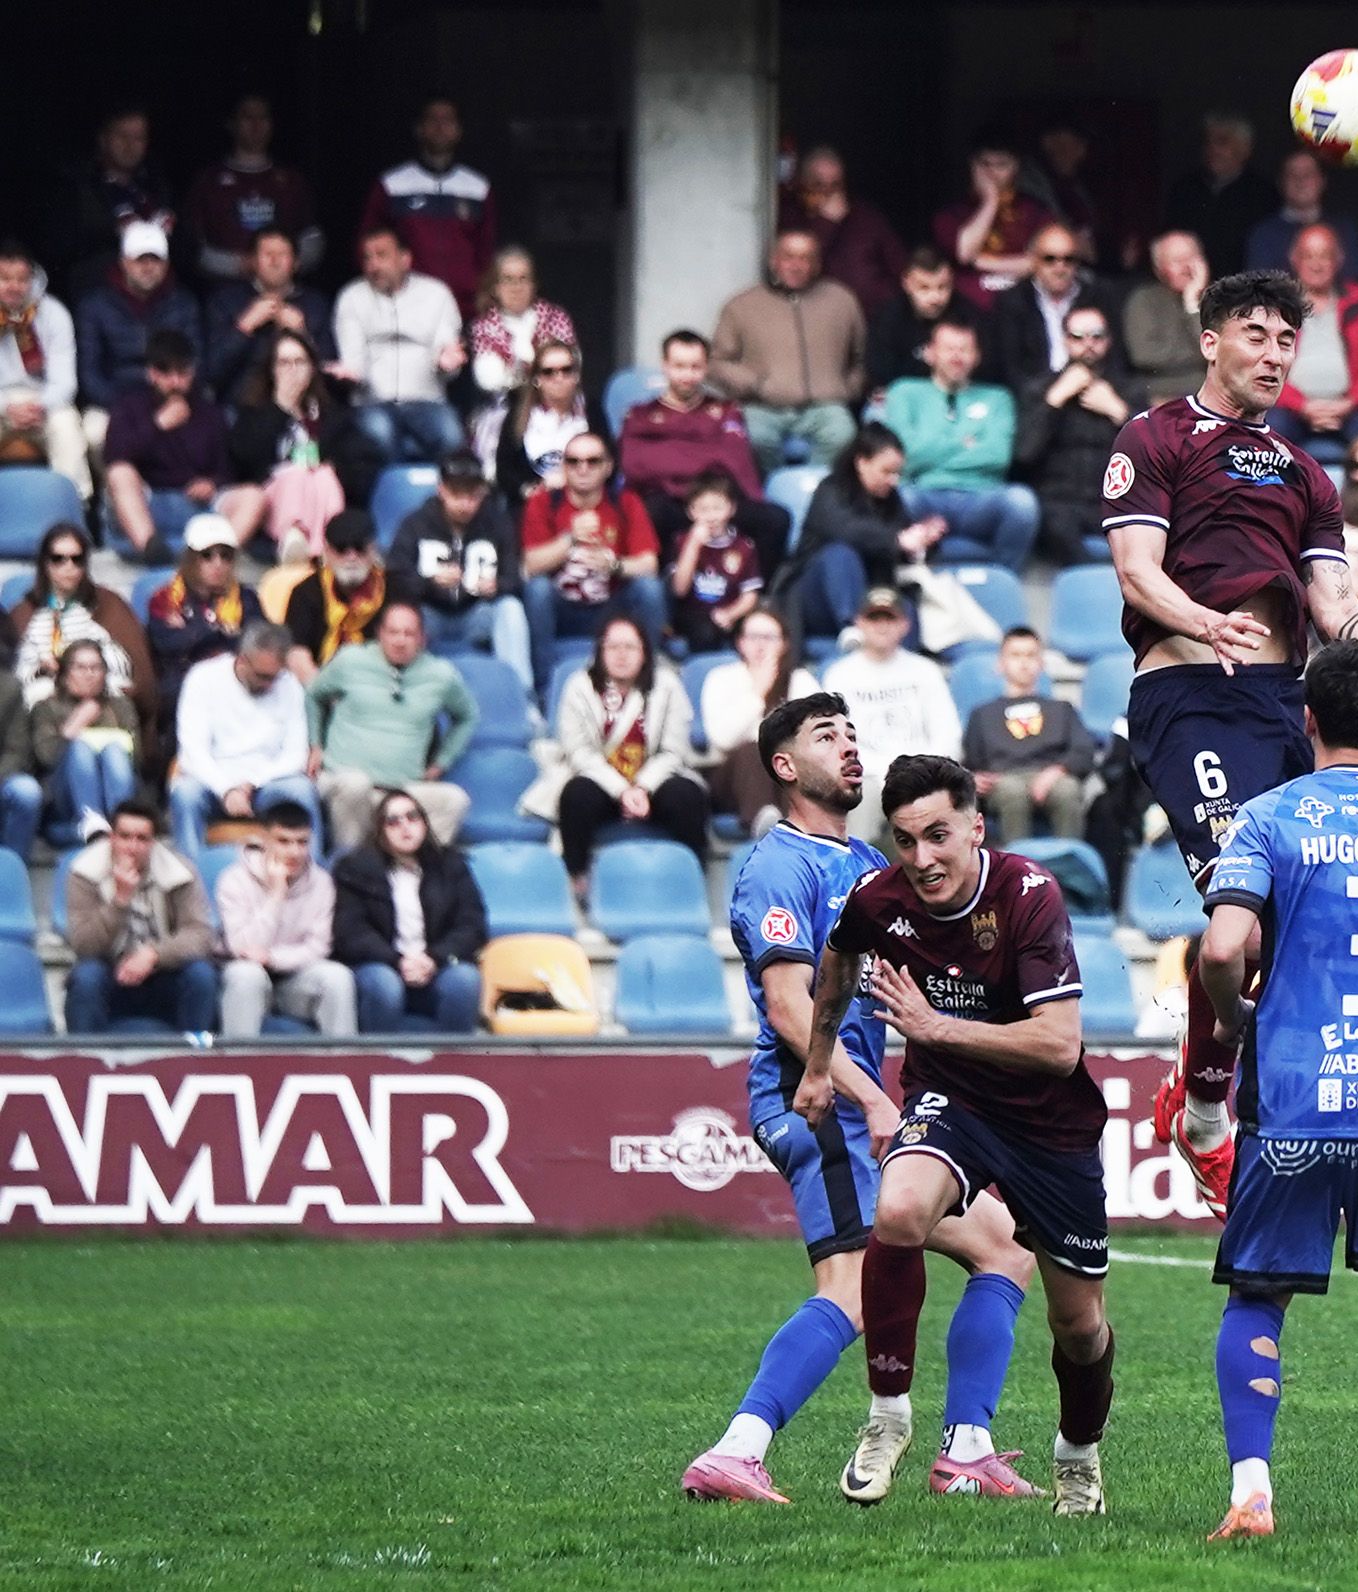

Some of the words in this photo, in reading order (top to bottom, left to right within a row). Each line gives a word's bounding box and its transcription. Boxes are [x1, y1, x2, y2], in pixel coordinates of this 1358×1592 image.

[1193, 750, 1228, 799] 6
[1205, 798, 1231, 809] XUNTA
[926, 974, 985, 996] Estrella
[915, 1091, 949, 1116] 2
